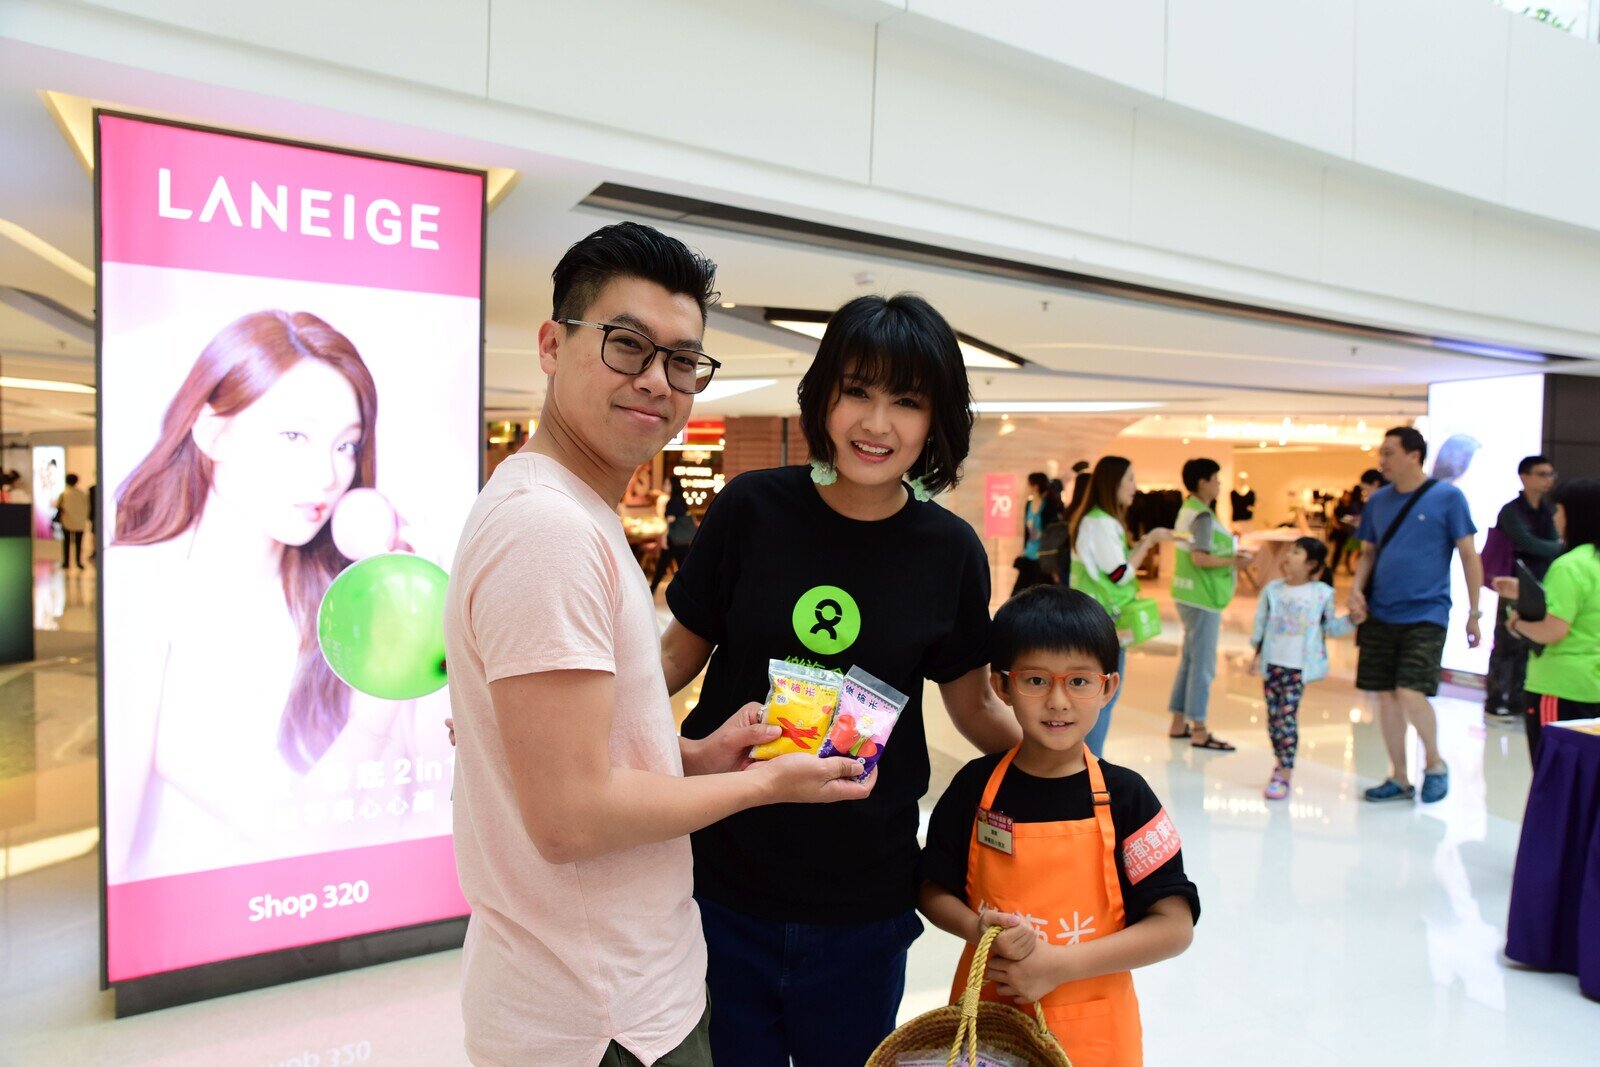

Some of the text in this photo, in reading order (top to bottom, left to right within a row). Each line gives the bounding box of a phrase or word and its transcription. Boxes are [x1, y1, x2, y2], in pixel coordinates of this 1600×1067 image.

[158, 167, 441, 251] LANEIGE
[248, 879, 369, 922] Shop 320
